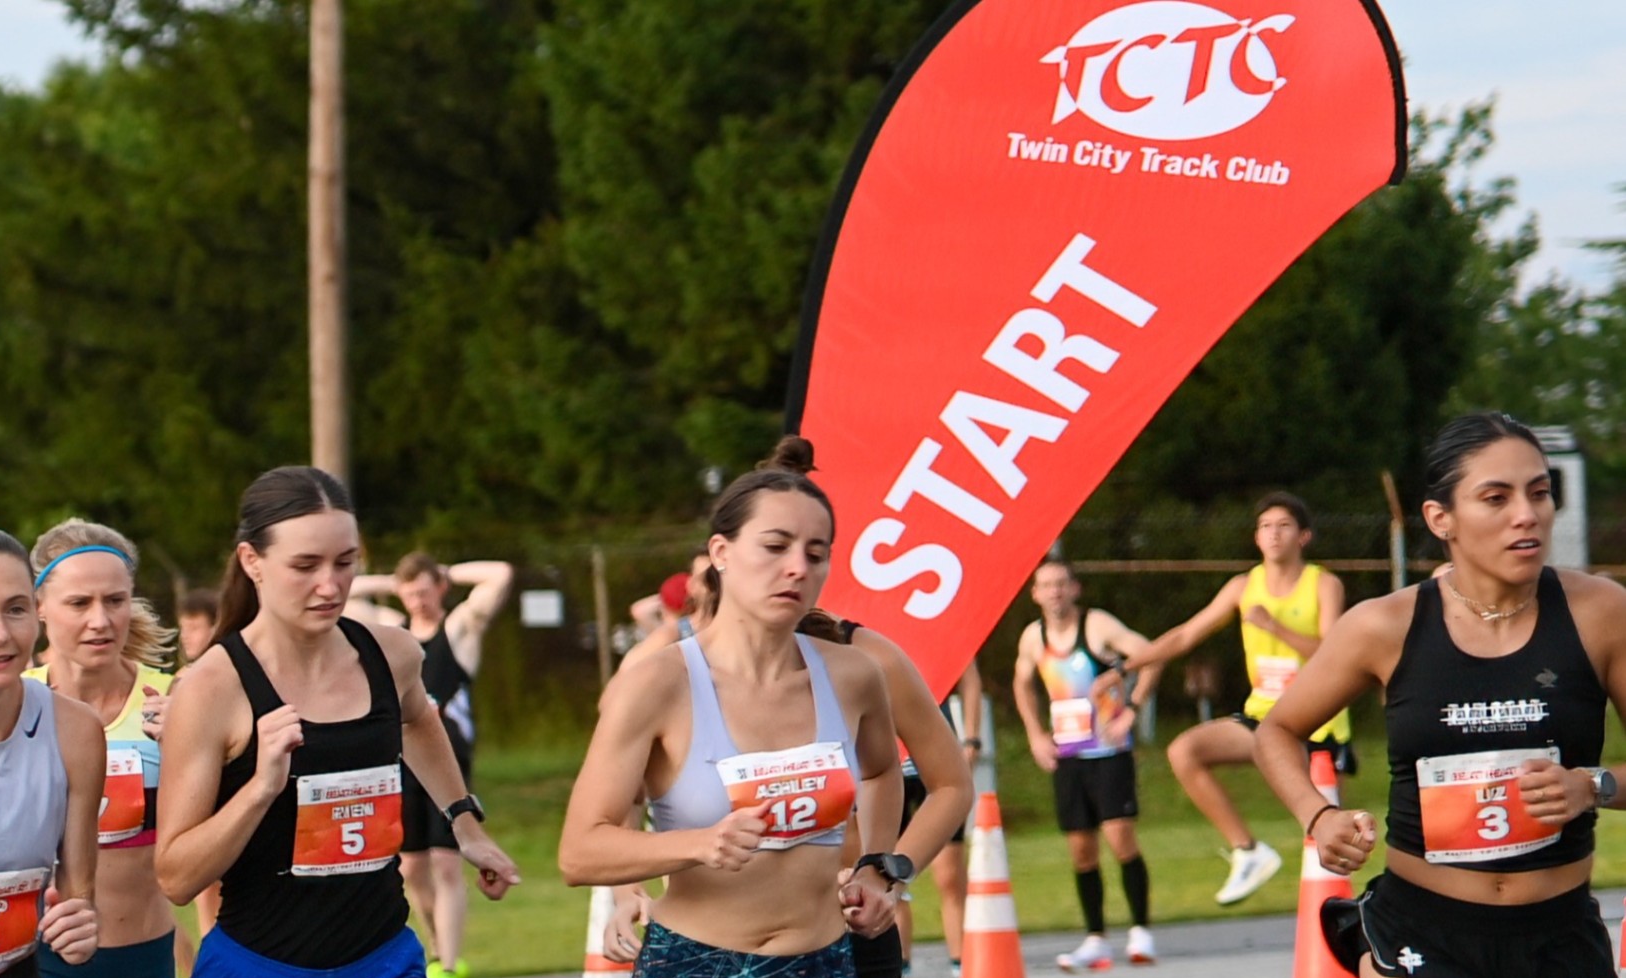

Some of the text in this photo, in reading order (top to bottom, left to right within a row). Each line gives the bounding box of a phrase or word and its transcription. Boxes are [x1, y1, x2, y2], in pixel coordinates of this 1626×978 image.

[1039, 14, 1296, 124] TCTC
[1007, 132, 1290, 186] Twin City Track Club
[850, 232, 1158, 620] START
[755, 775, 827, 800] ASHLEY
[769, 796, 818, 832] 12
[1476, 805, 1510, 840] 3
[340, 821, 366, 855] 5
